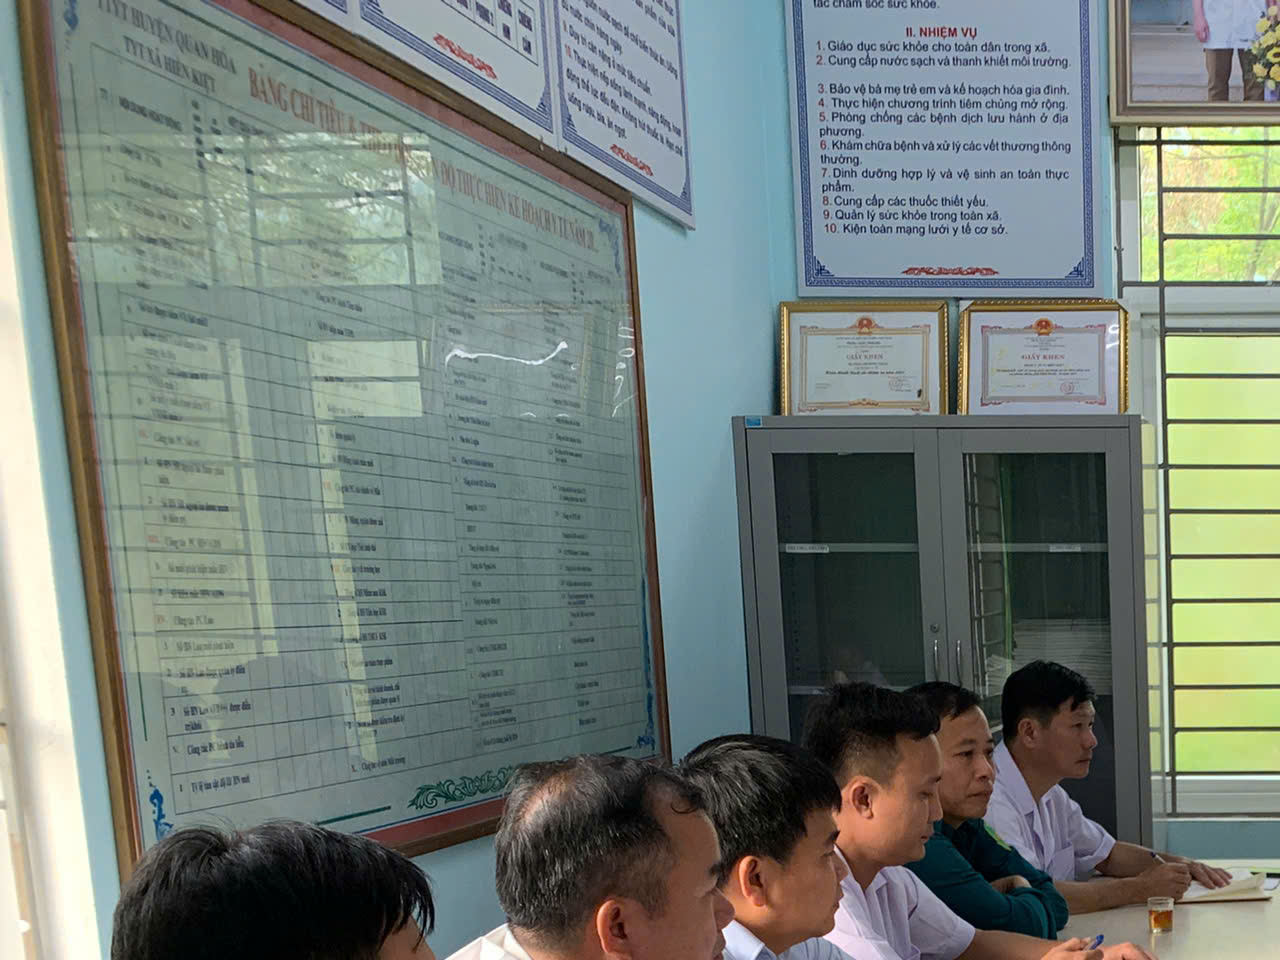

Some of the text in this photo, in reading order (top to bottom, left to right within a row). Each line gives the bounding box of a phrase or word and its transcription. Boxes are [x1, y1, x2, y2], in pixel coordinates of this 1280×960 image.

[906, 27, 977, 40] II. NHIỆM VỤ
[828, 40, 853, 52] Giáo
[857, 41, 877, 54] dục
[880, 41, 900, 52] sức
[903, 40, 928, 52] khỏe
[932, 41, 951, 52] cho
[954, 42, 978, 52] toàn
[981, 42, 1001, 52] dân
[1004, 42, 1031, 54] trong
[1035, 42, 1050, 52] xã.
[828, 55, 856, 68] Cung
[859, 54, 878, 68] cấp
[880, 55, 908, 66] nước
[910, 55, 935, 68] sạch
[938, 56, 950, 66] và
[952, 56, 982, 66] thanh
[984, 54, 1009, 66] khiết
[1011, 55, 1030, 66] môi
[1032, 56, 1071, 68] trường.
[248, 63, 288, 112] BẢNG
[830, 83, 851, 94] Bảo
[854, 84, 866, 96] vệ
[868, 84, 882, 94] bà
[884, 86, 900, 96] mẹ
[903, 84, 917, 94] trẻ
[919, 86, 936, 94] em
[938, 84, 951, 95] và
[953, 82, 966, 94] kế
[968, 84, 1000, 96] hoạch
[1003, 84, 1022, 95] hóa
[1025, 84, 1041, 98] gia
[1043, 84, 1070, 95] đình.
[831, 97, 859, 110] Thực
[862, 98, 884, 110] hiện
[888, 98, 929, 111] chương
[932, 98, 956, 109] trình
[960, 98, 982, 109] tiêm
[985, 98, 1017, 111] chủng
[1021, 98, 1038, 109] mở
[1042, 98, 1068, 111] rộng.
[832, 112, 866, 124] Phòng
[870, 111, 902, 125] chống
[907, 112, 926, 123] các
[930, 112, 956, 125] bệnh
[961, 113, 983, 125] dịch
[988, 113, 1004, 123] lưu
[1009, 112, 1036, 123] hành
[1040, 112, 1048, 123] ở
[1052, 113, 1068, 124] địa
[820, 125, 864, 139] phương.
[833, 168, 857, 179] Dinh
[862, 168, 897, 181] dưỡng
[902, 168, 922, 181] hợp
[927, 168, 936, 181] lý
[940, 168, 952, 179] và
[957, 169, 970, 180] vệ
[974, 169, 996, 179] sinh
[1000, 171, 1013, 179] an
[1018, 168, 1041, 179] toàn
[1046, 169, 1069, 180] thực
[822, 180, 854, 194] phẩm.
[834, 195, 862, 208] Cung
[865, 194, 885, 208] cấp
[888, 196, 906, 206] các
[909, 194, 938, 207] thuốc
[941, 194, 964, 206] thiết
[966, 194, 988, 208] yếu.
[835, 209, 864, 220] Quản
[867, 209, 876, 222] lý
[879, 210, 899, 220] sức
[902, 210, 927, 220] khỏe
[930, 211, 957, 222] trong
[960, 210, 983, 220] toàn
[986, 211, 1002, 221] xã.
[843, 223, 866, 235] Kiện
[870, 223, 892, 234] toàn
[896, 226, 925, 237] mạng
[928, 224, 949, 234] lưới
[952, 222, 958, 237] y
[962, 222, 971, 234] tế
[974, 226, 988, 234] cơ
[992, 224, 1008, 234] sở.
